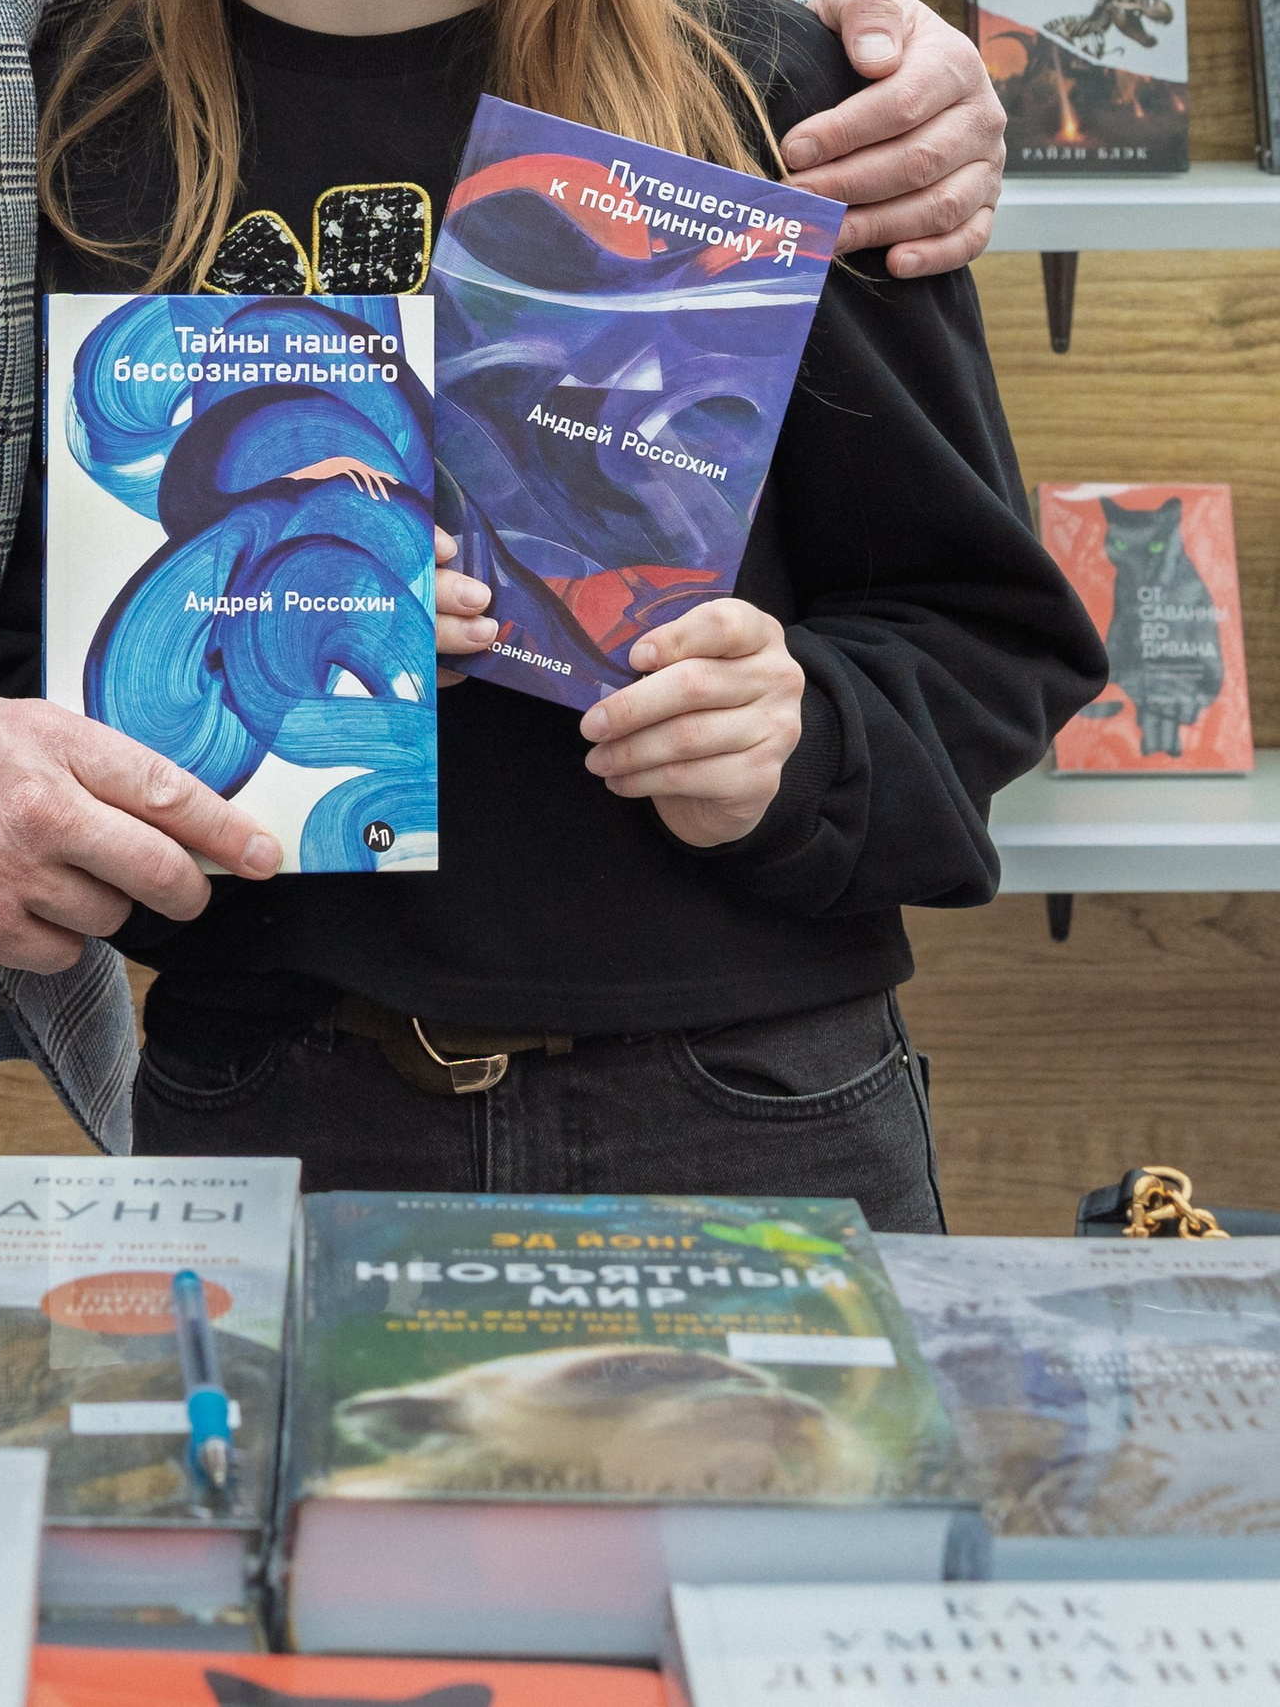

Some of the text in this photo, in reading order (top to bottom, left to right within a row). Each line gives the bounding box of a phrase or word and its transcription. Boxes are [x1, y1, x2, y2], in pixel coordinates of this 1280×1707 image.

[1021, 144, 1149, 161] РАЙЛИ БЛЭК
[606, 159, 803, 241] Путешествие
[548, 177, 800, 268] к подлинному Я
[175, 326, 399, 356] Тайны нашего
[113, 355, 399, 384] бессознательного
[526, 403, 729, 483] Андрей Россохин
[183, 591, 395, 616] Андрей Россохин
[1137, 585, 1162, 604] ОТ
[1138, 603, 1229, 623] САВАННЫ
[1140, 621, 1170, 641] ДО
[487, 640, 573, 676] оанализа
[1141, 640, 1218, 660] ДИВАНА
[33, 1176, 116, 1187] РОСС
[132, 1176, 250, 1188] МАКФИ
[490, 1228, 700, 1250] ЭД ЙОНГ
[355, 1260, 849, 1289] НЕОБЪЯТНЫЙ
[528, 1285, 688, 1308] МИР
[944, 1596, 1103, 1621] КАК
[823, 1627, 1246, 1655] УМИРАЛИ
[763, 1660, 1280, 1690] ДИНОЗАВР
